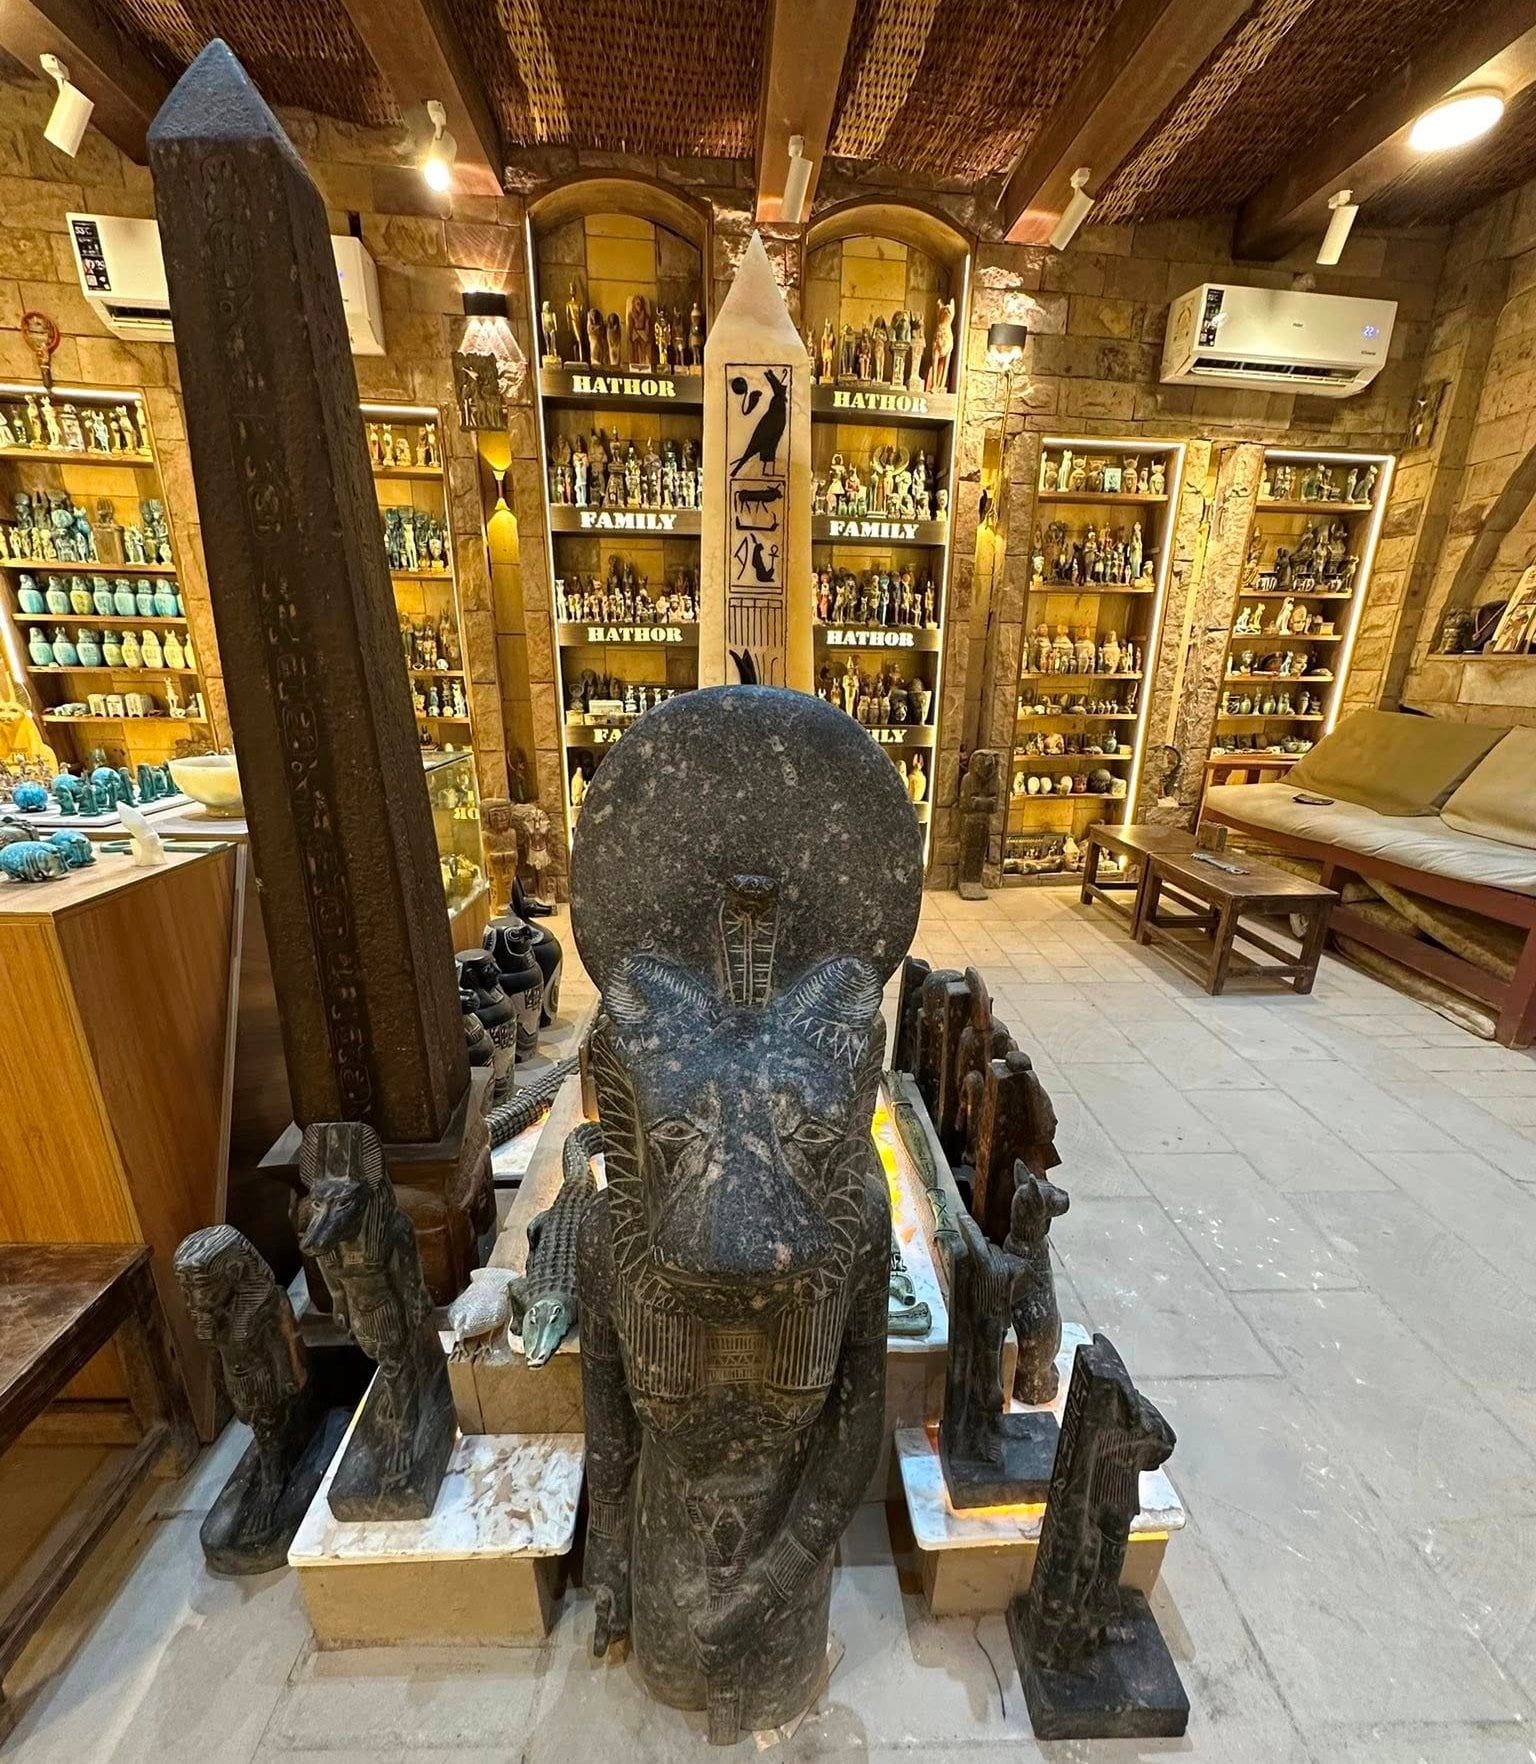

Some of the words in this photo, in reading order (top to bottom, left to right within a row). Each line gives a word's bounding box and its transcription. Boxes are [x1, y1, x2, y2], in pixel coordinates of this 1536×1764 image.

[572, 375, 676, 397] HATHOR
[833, 391, 928, 413] HATHOR
[580, 511, 677, 530] FAMILY
[829, 520, 919, 539] FAMILY
[587, 627, 683, 642] HATHOR
[826, 630, 914, 647] HATHOR
[868, 729, 907, 743] ILY
